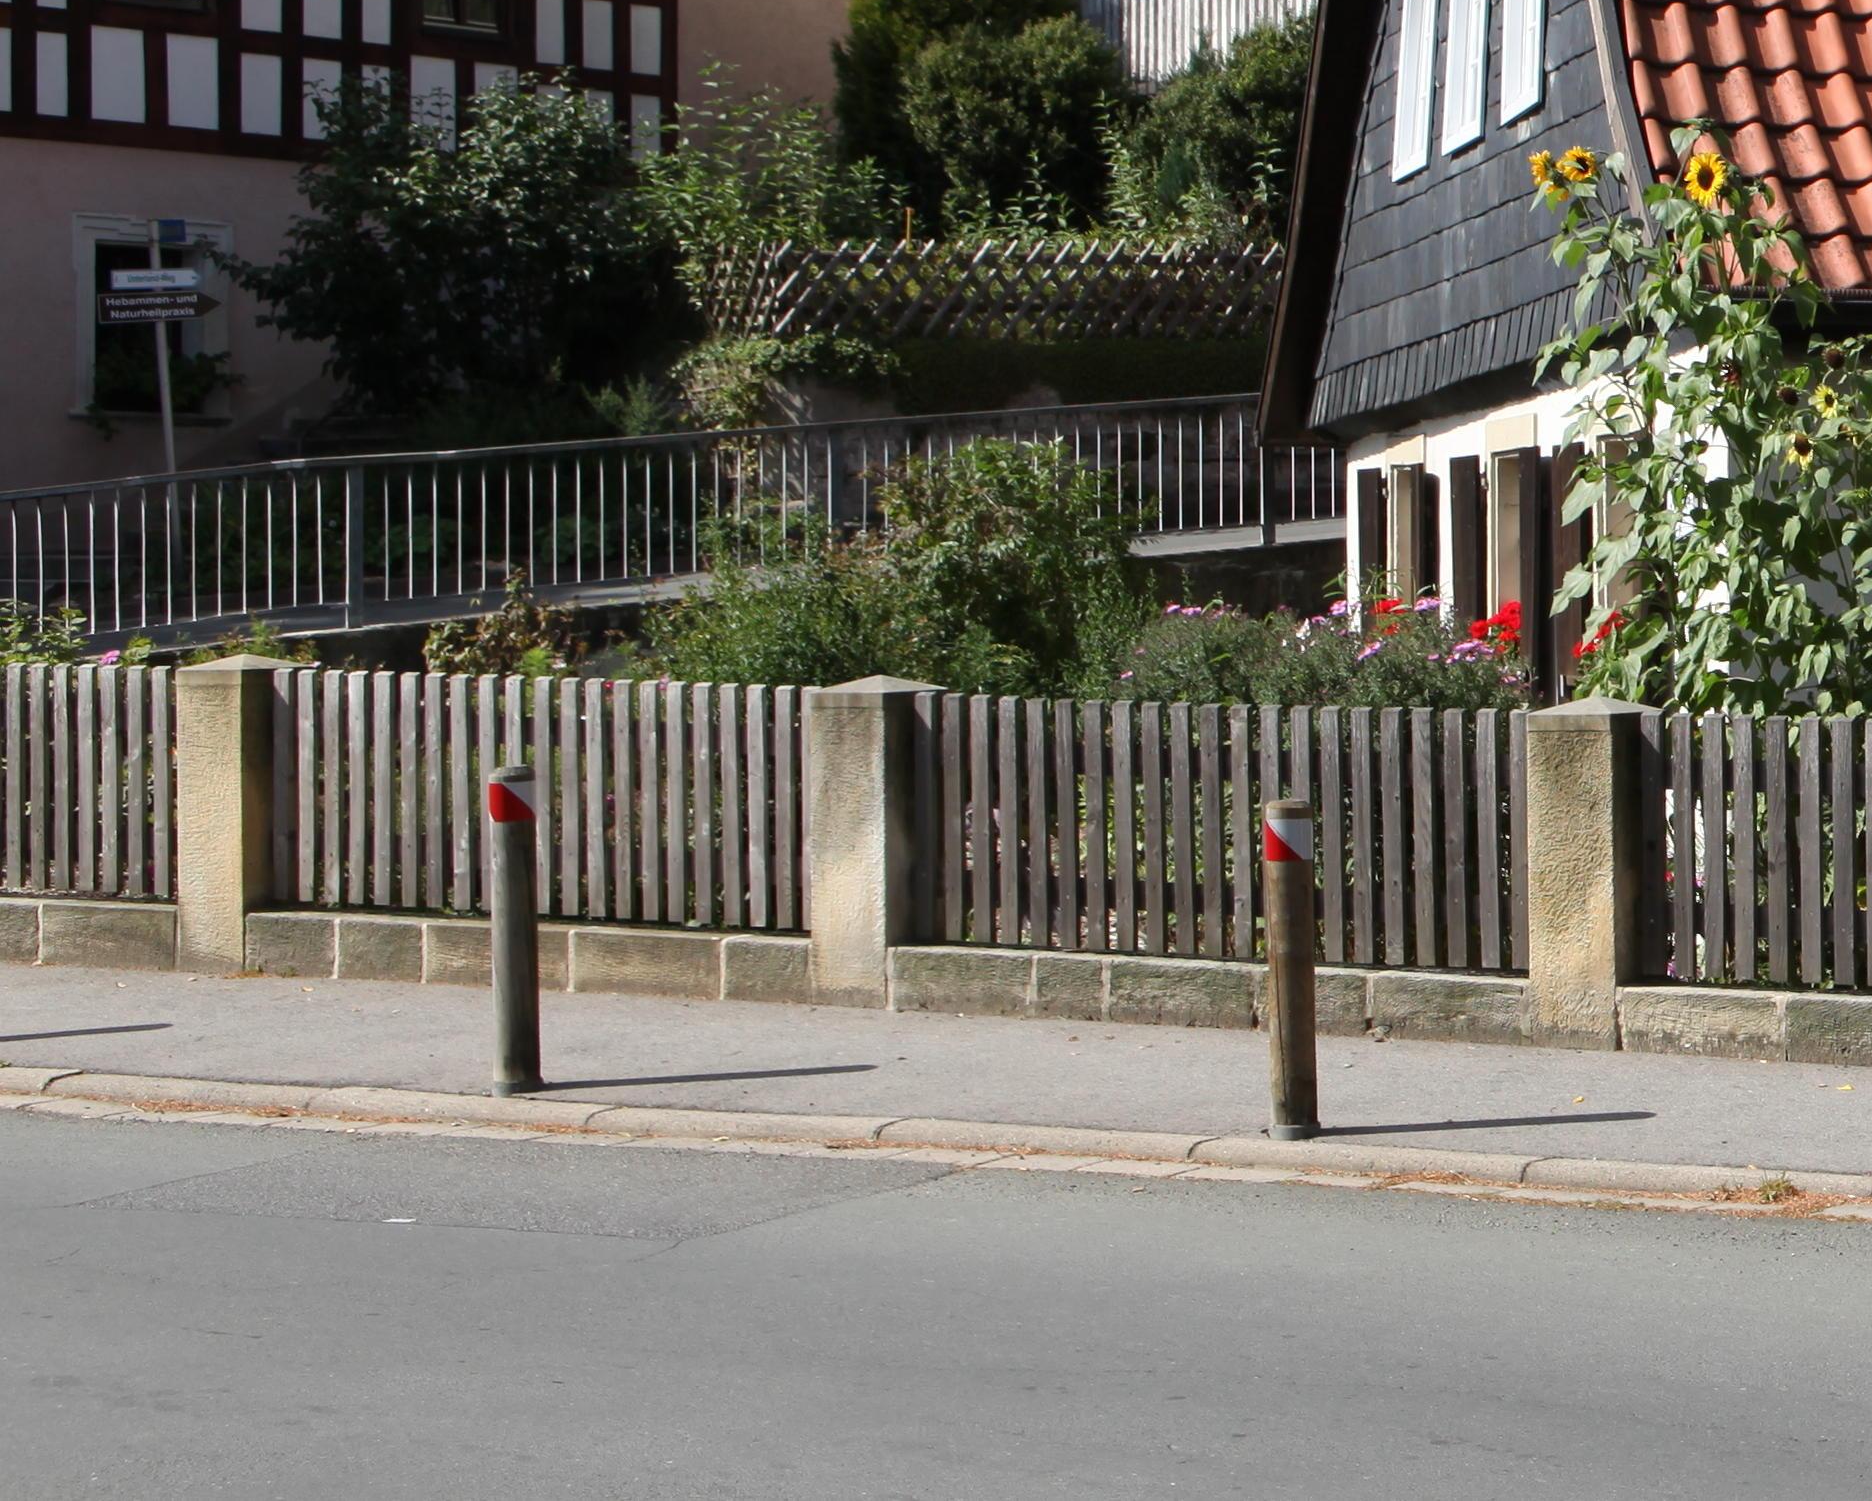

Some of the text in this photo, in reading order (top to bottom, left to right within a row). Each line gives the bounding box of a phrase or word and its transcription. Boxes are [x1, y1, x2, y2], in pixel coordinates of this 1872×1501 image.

[105, 294, 198, 307] Hebammen- und
[110, 307, 195, 320] Naturheilpraxis
